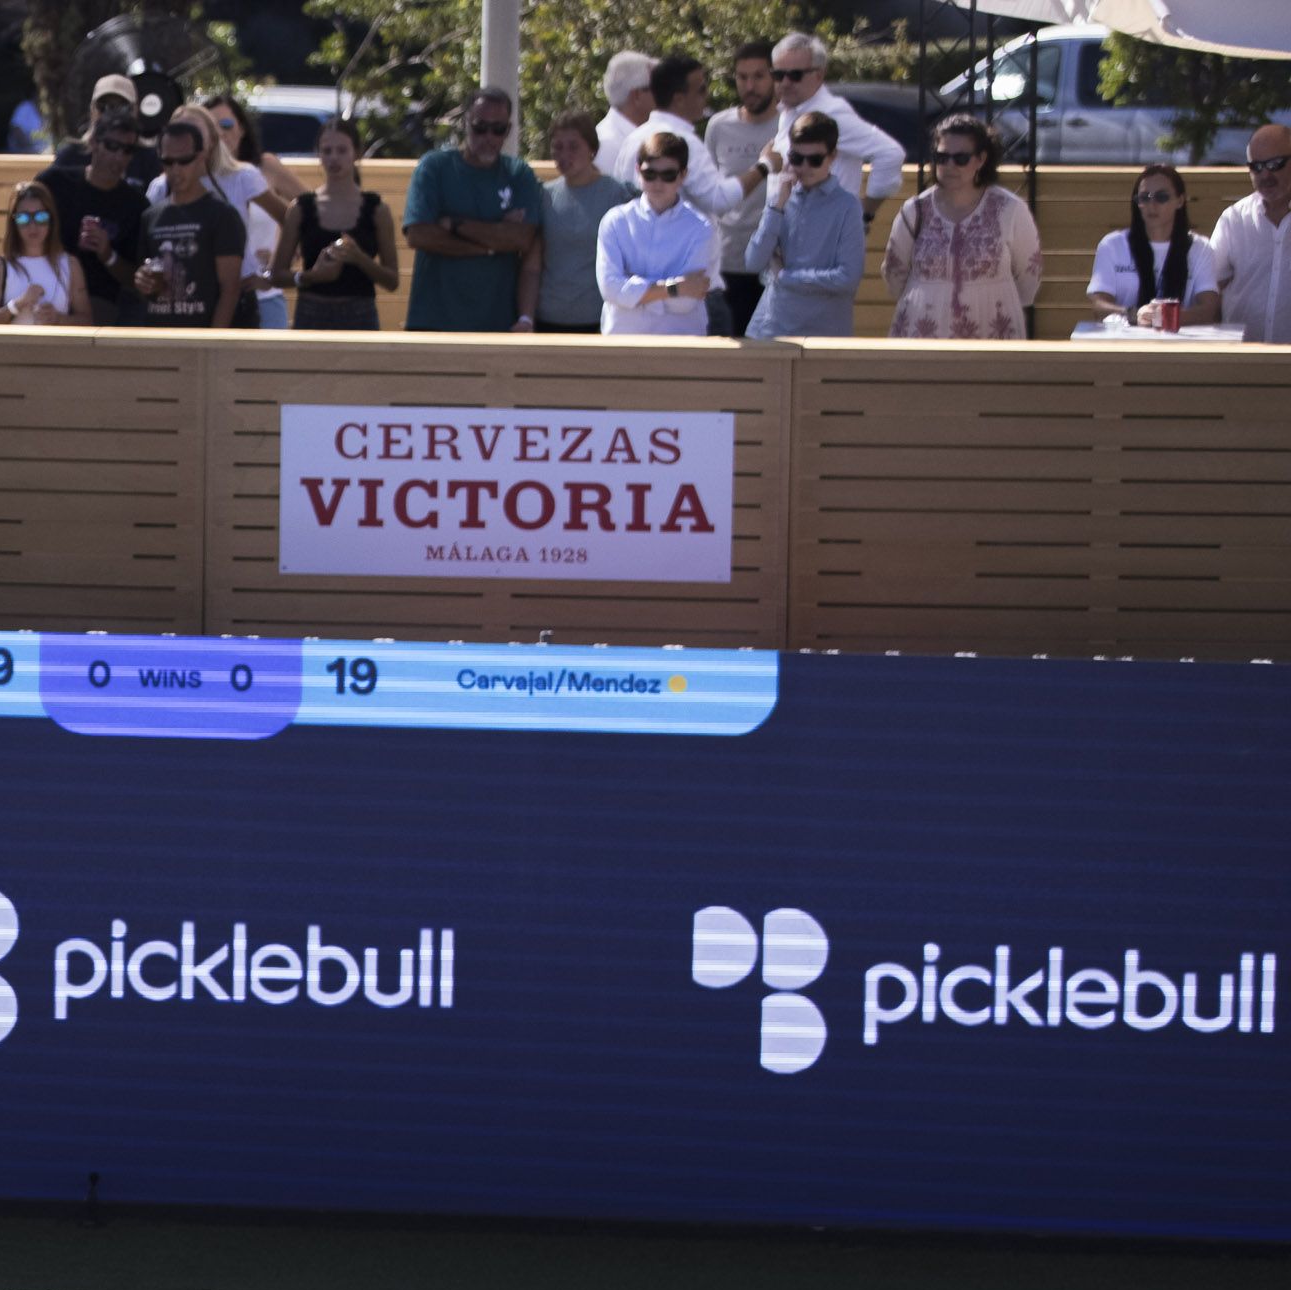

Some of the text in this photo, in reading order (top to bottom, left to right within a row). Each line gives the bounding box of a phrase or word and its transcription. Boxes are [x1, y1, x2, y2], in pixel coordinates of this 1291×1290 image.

[333, 421, 682, 465] CERVEZAS
[299, 477, 715, 534] VICTORIA
[425, 541, 589, 564] MÁLAGA 1928
[88, 659, 253, 692] 0 WINS 0
[325, 657, 379, 695] 19
[456, 667, 662, 695] Carvajal/Mendez
[54, 918, 455, 1020] picklebull
[862, 942, 1277, 1046] picklebull
